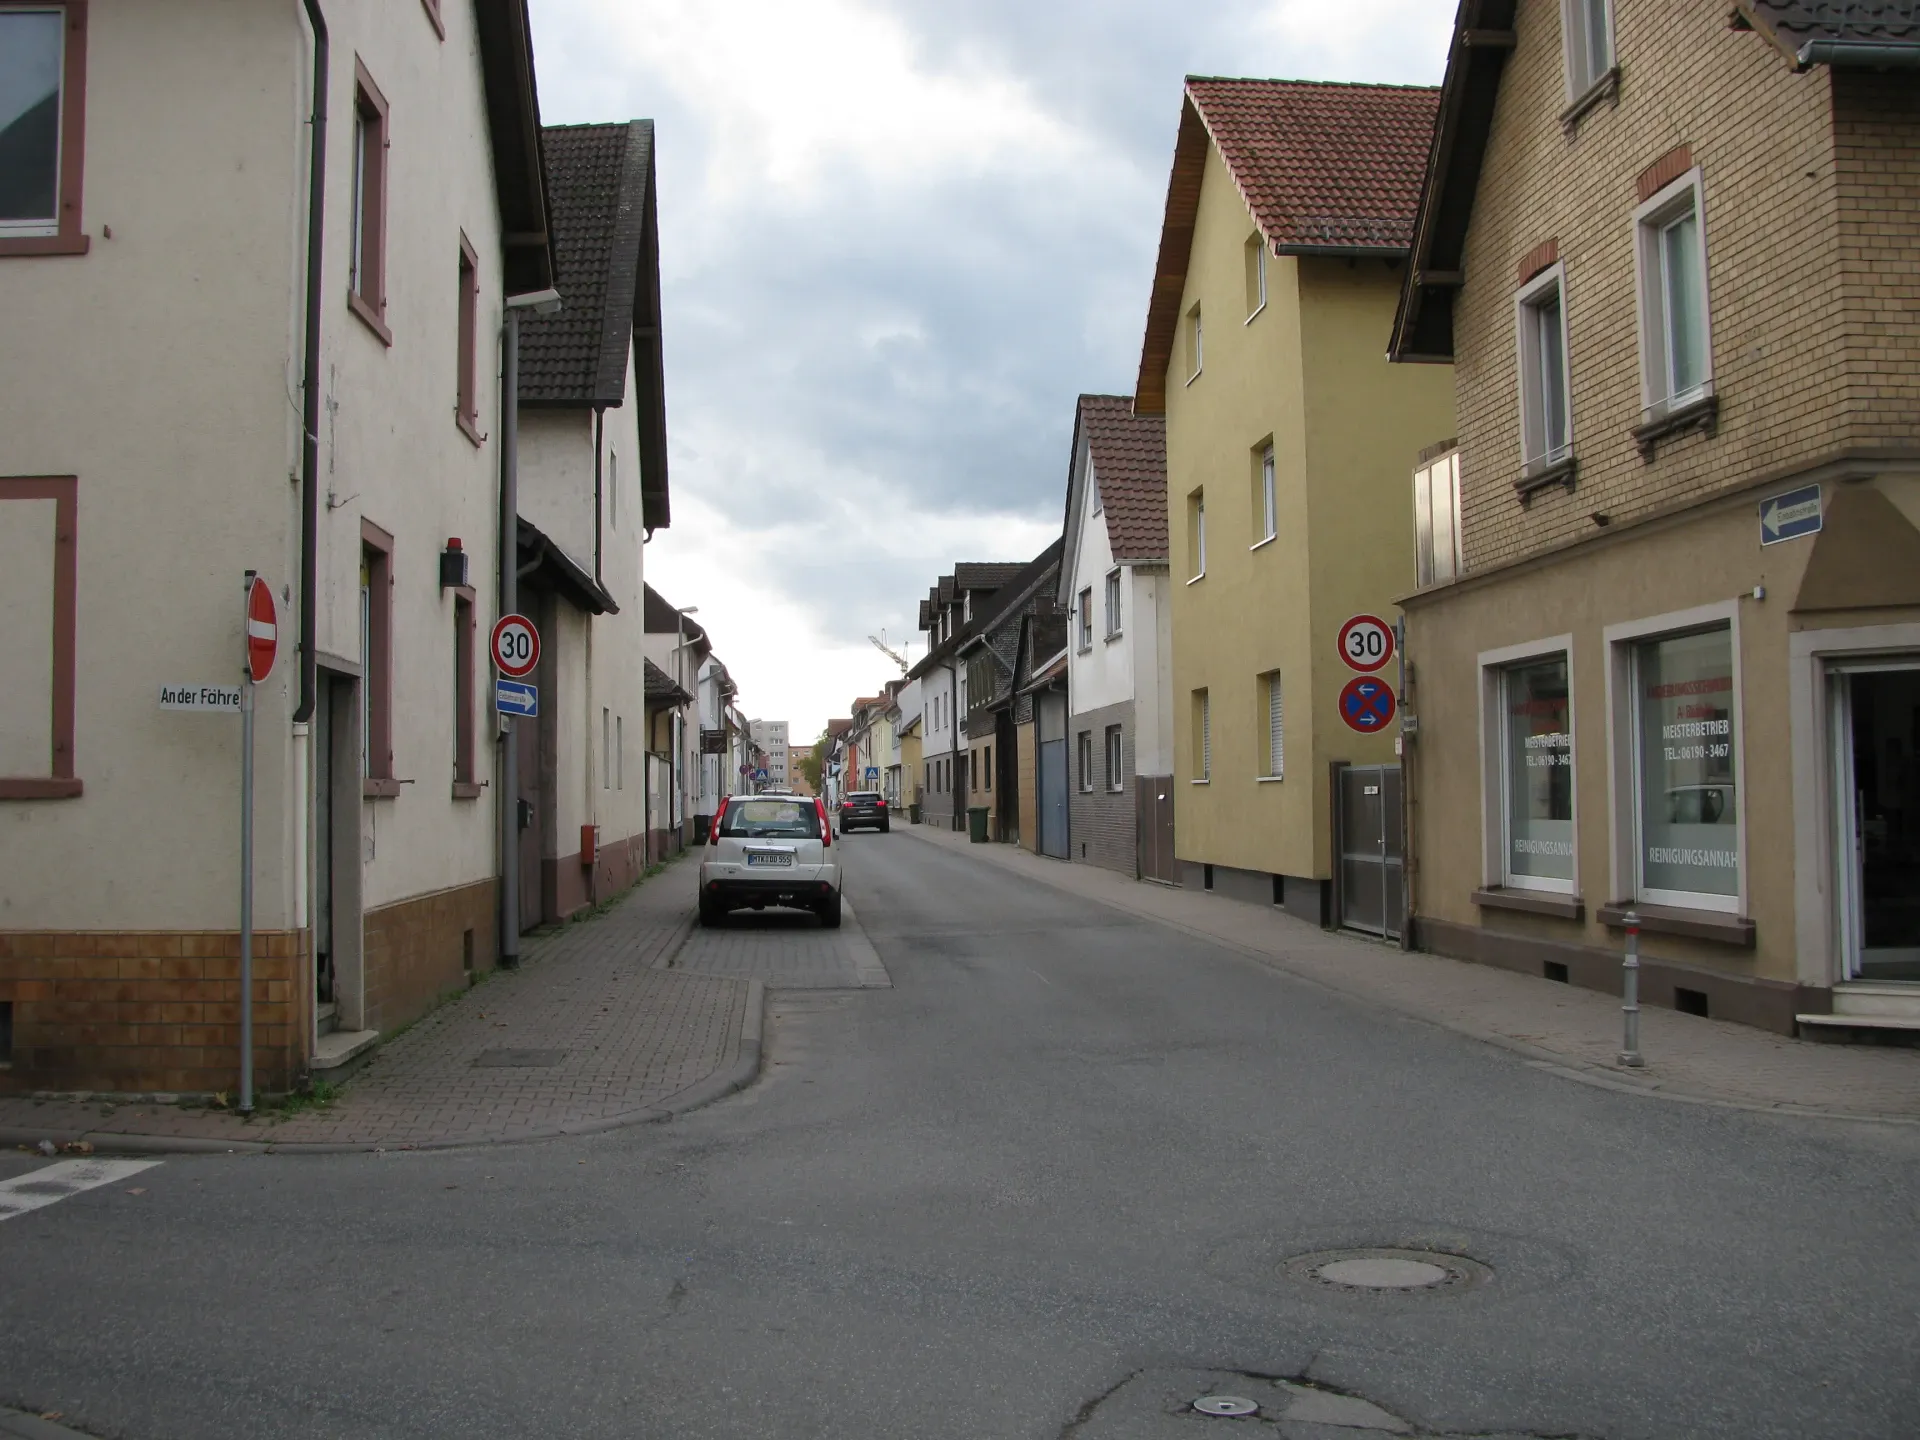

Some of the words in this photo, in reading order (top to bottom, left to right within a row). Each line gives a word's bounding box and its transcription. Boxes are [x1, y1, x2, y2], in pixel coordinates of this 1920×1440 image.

[502, 631, 529, 659] 30
[1350, 631, 1382, 657] 30
[161, 687, 176, 704] An
[177, 687, 197, 704] der
[201, 688, 240, 705] Fähre
[1663, 720, 1729, 739] MEISTERBETRIEB
[1681, 745, 1704, 759] 06190
[1709, 743, 1729, 757] 3467
